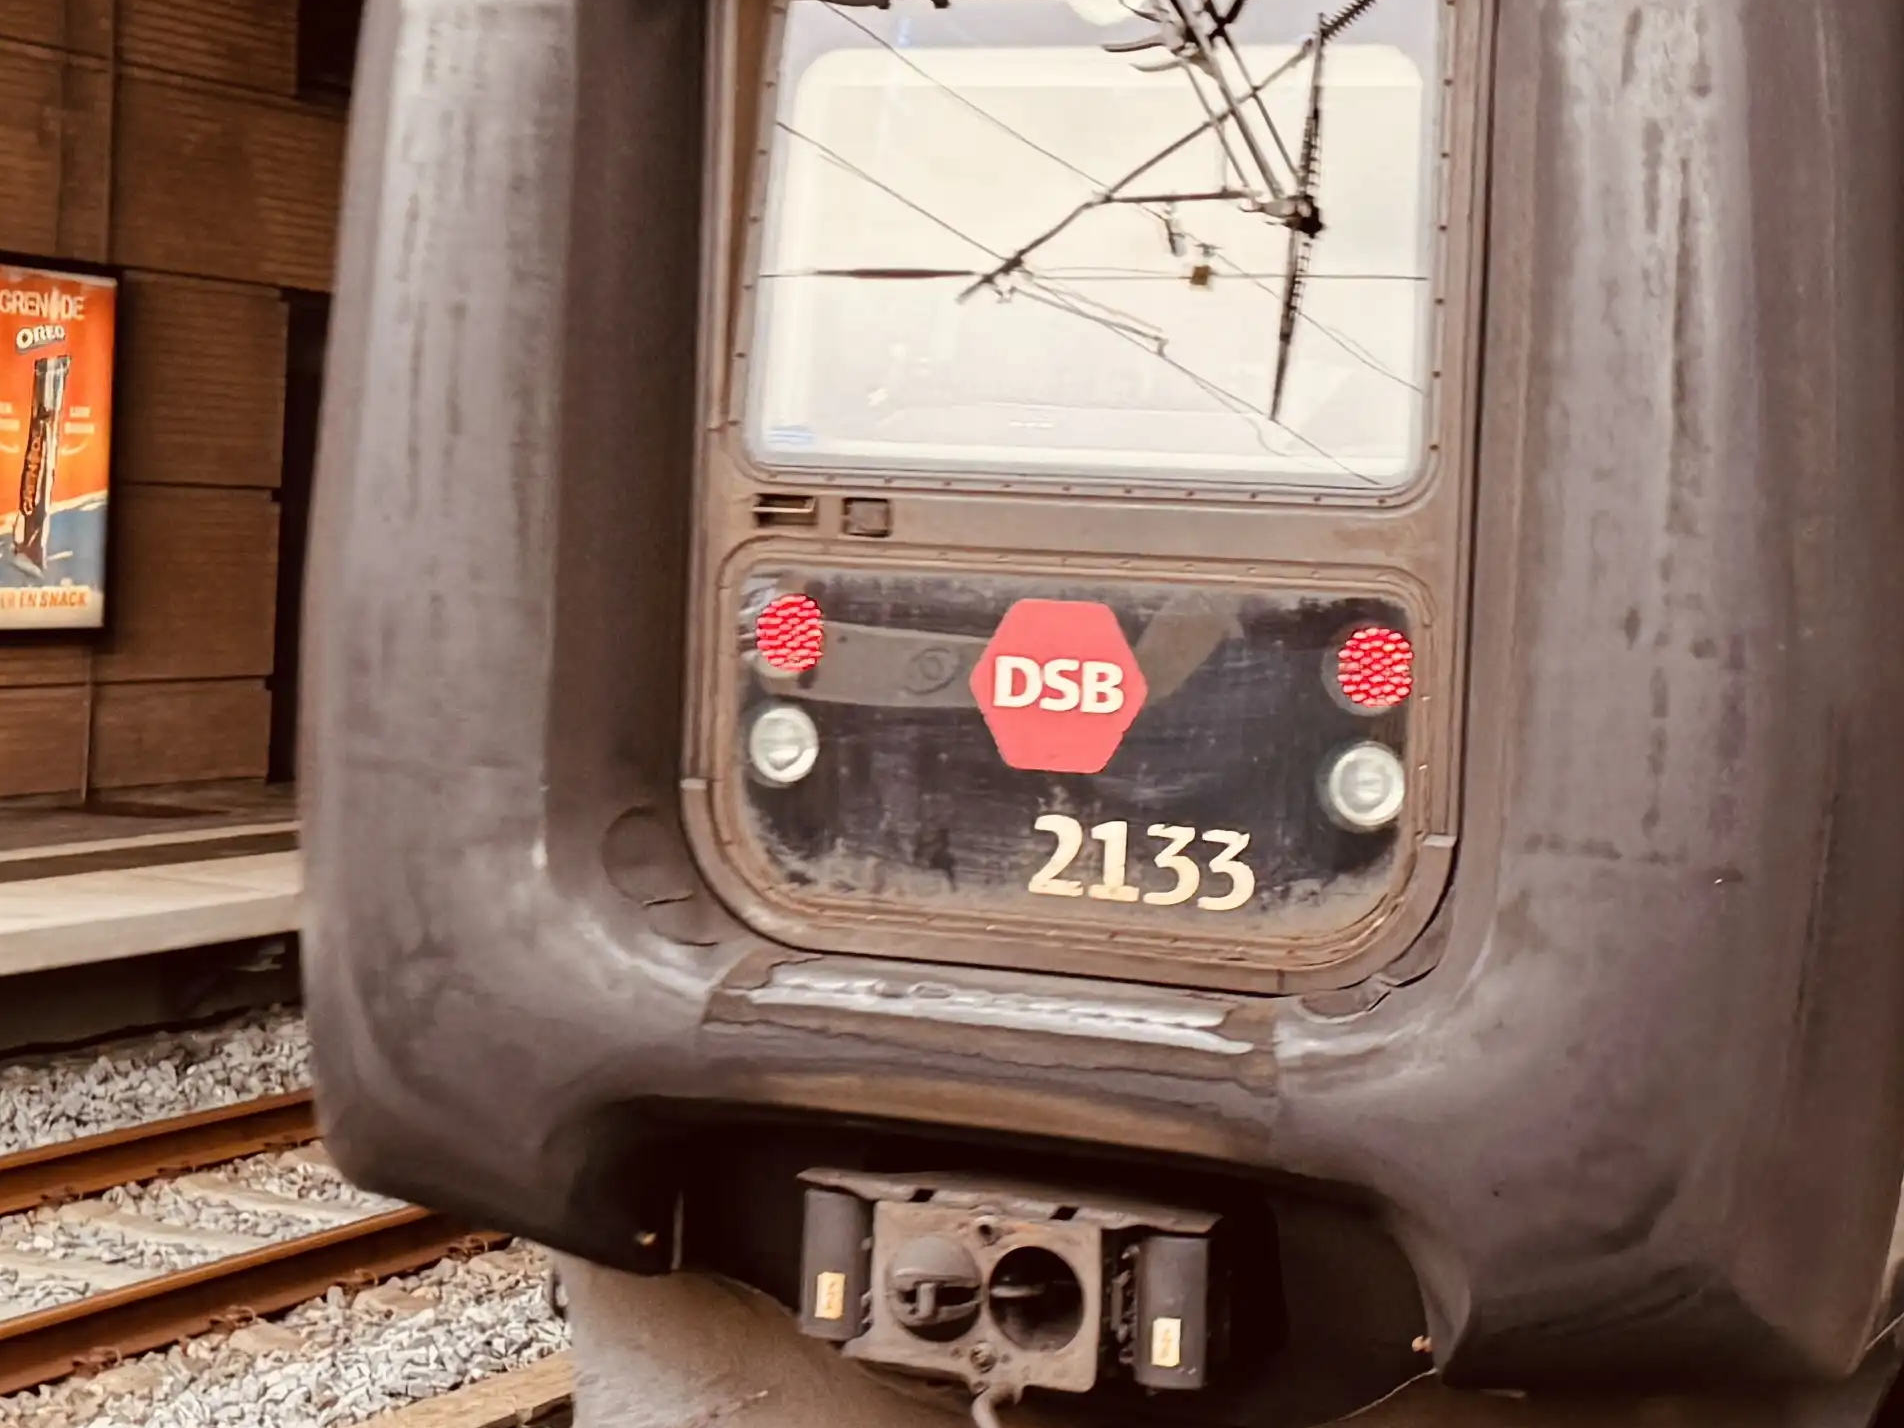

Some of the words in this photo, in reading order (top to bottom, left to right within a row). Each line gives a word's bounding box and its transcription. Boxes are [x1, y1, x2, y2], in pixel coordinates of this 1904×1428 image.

[16, 324, 66, 350] OREO
[39, 589, 88, 608] SNACK
[992, 654, 1125, 714] DSB
[1027, 813, 1256, 911] 2133
